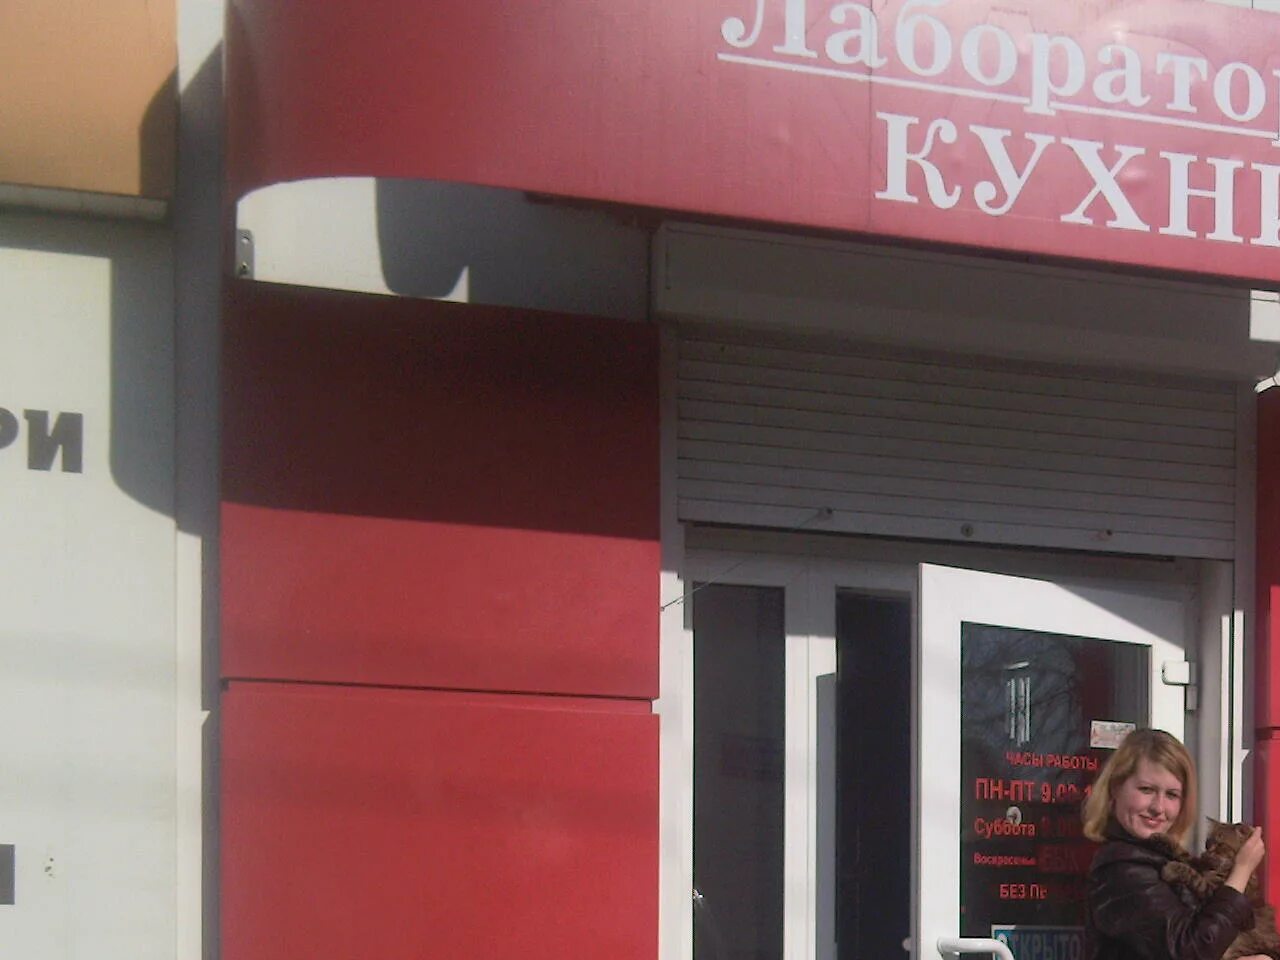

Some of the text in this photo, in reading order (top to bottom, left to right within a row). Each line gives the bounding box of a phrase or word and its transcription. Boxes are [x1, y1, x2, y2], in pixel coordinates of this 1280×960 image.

[1006, 751, 1098, 771] ЧАСЫ РАБОТЫ
[976, 777, 1035, 802] ПН-ПТ
[974, 817, 1036, 840] Суббота
[1000, 883, 1026, 899] БЕЗ
